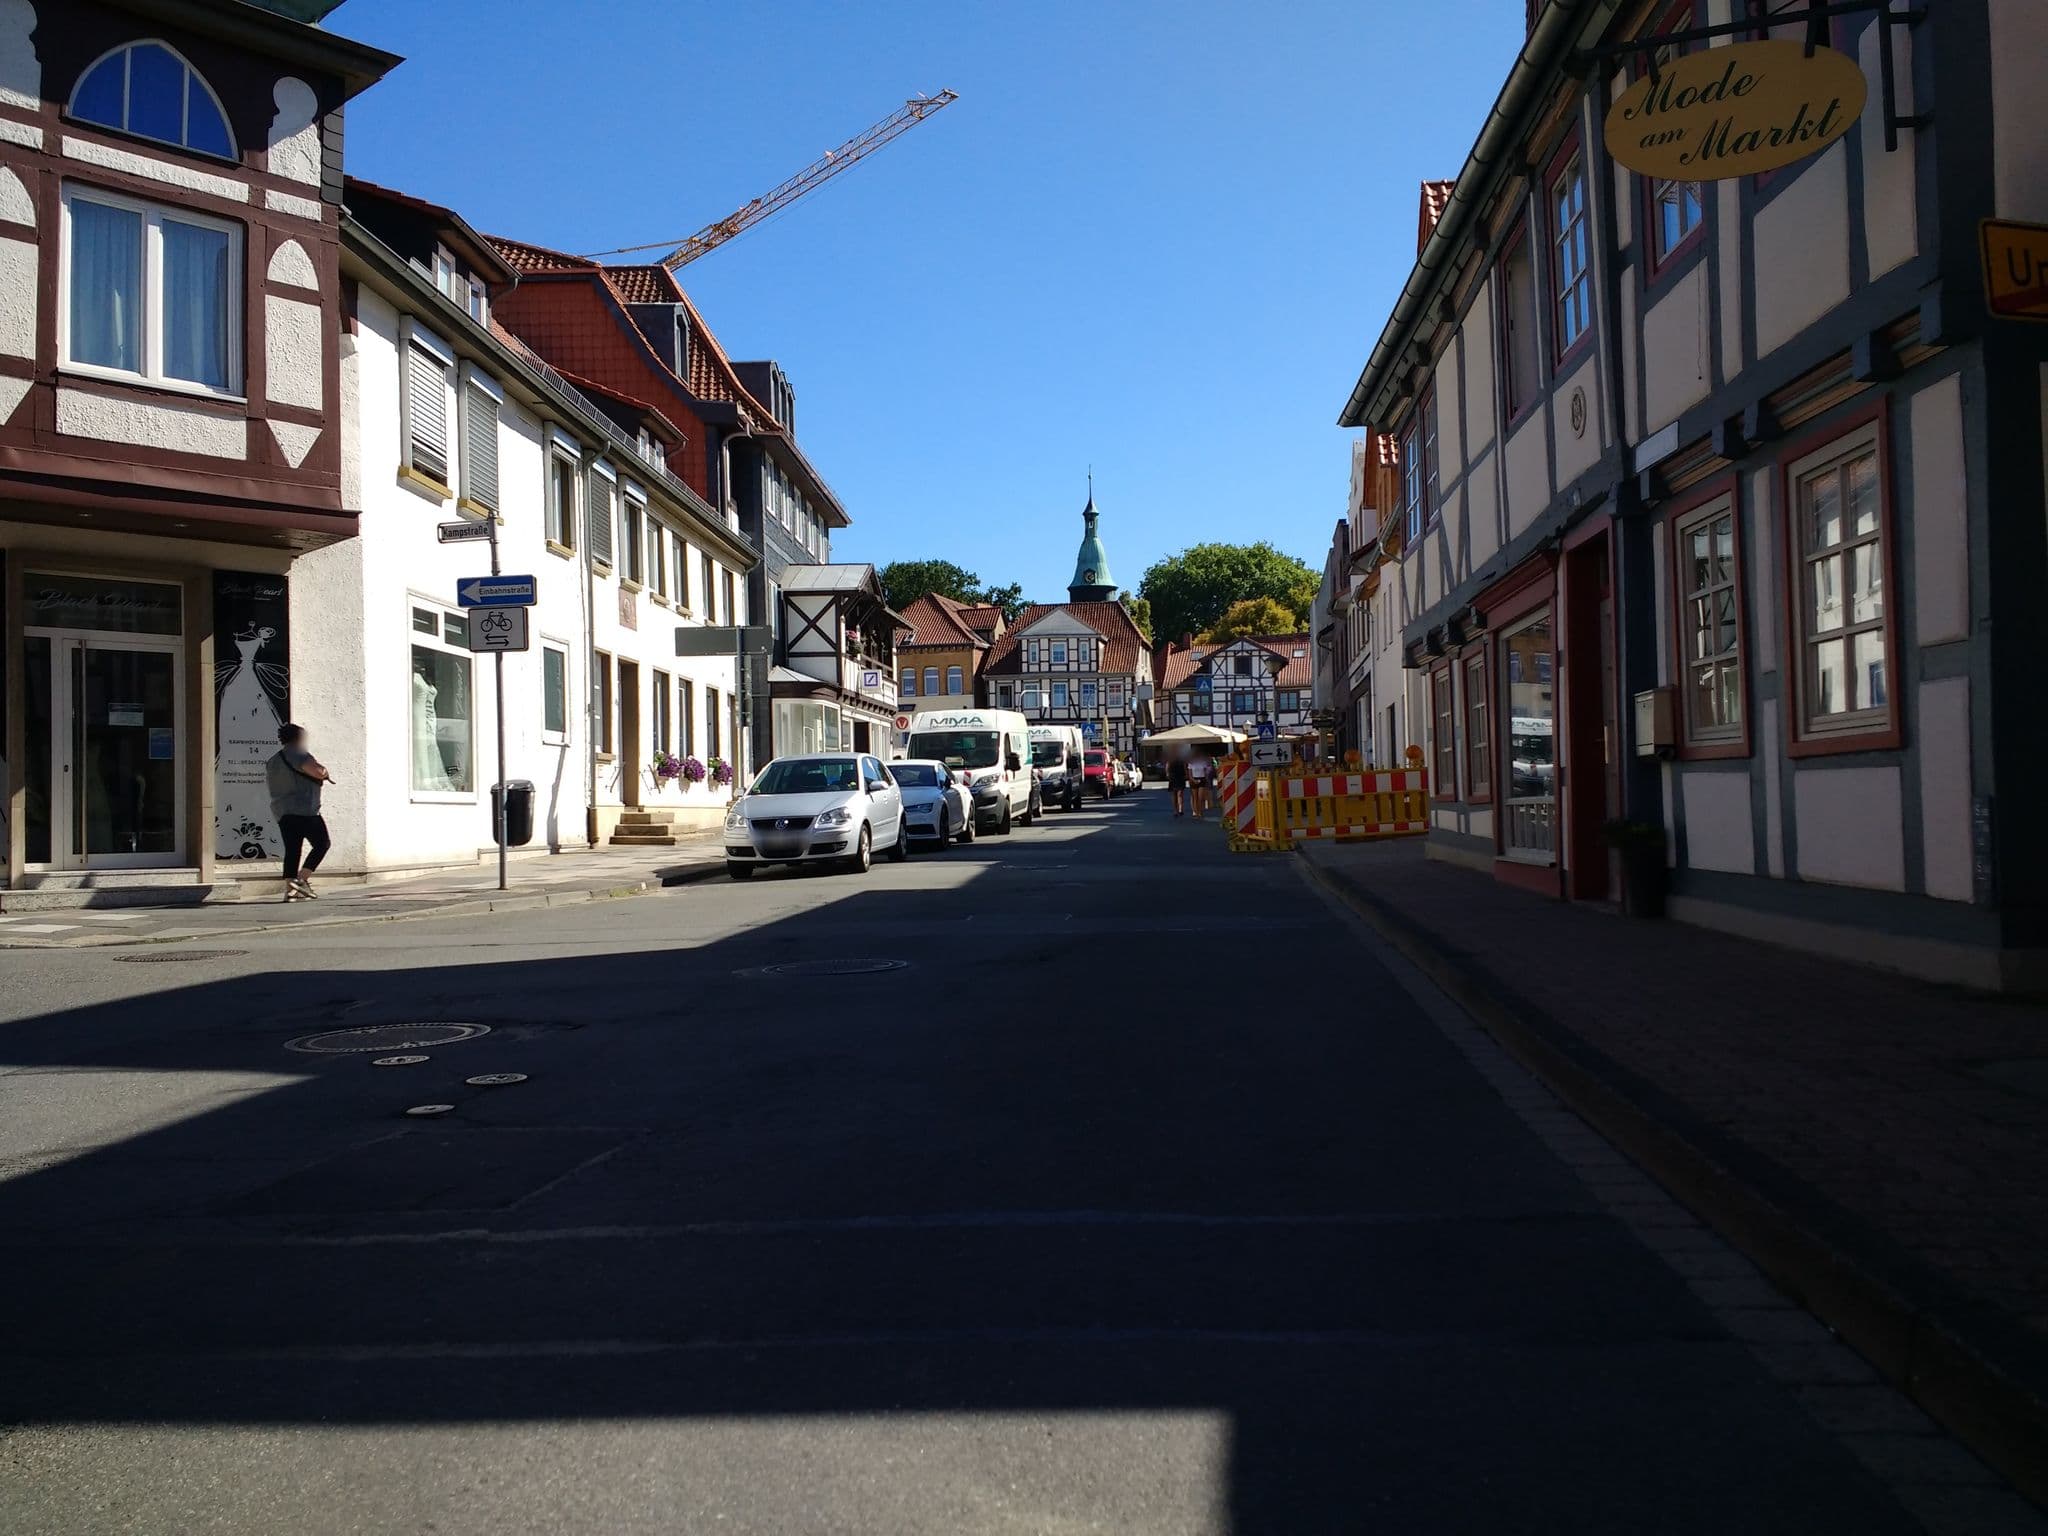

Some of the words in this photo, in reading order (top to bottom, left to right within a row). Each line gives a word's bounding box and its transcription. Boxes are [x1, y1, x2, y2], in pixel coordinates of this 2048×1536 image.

[1623, 61, 1766, 121] Mode
[1639, 127, 1686, 149] am
[1680, 98, 1844, 165] Markt
[443, 525, 488, 539] Kampstraße
[478, 585, 530, 595] Einbahnstraße
[930, 717, 983, 729] MMA
